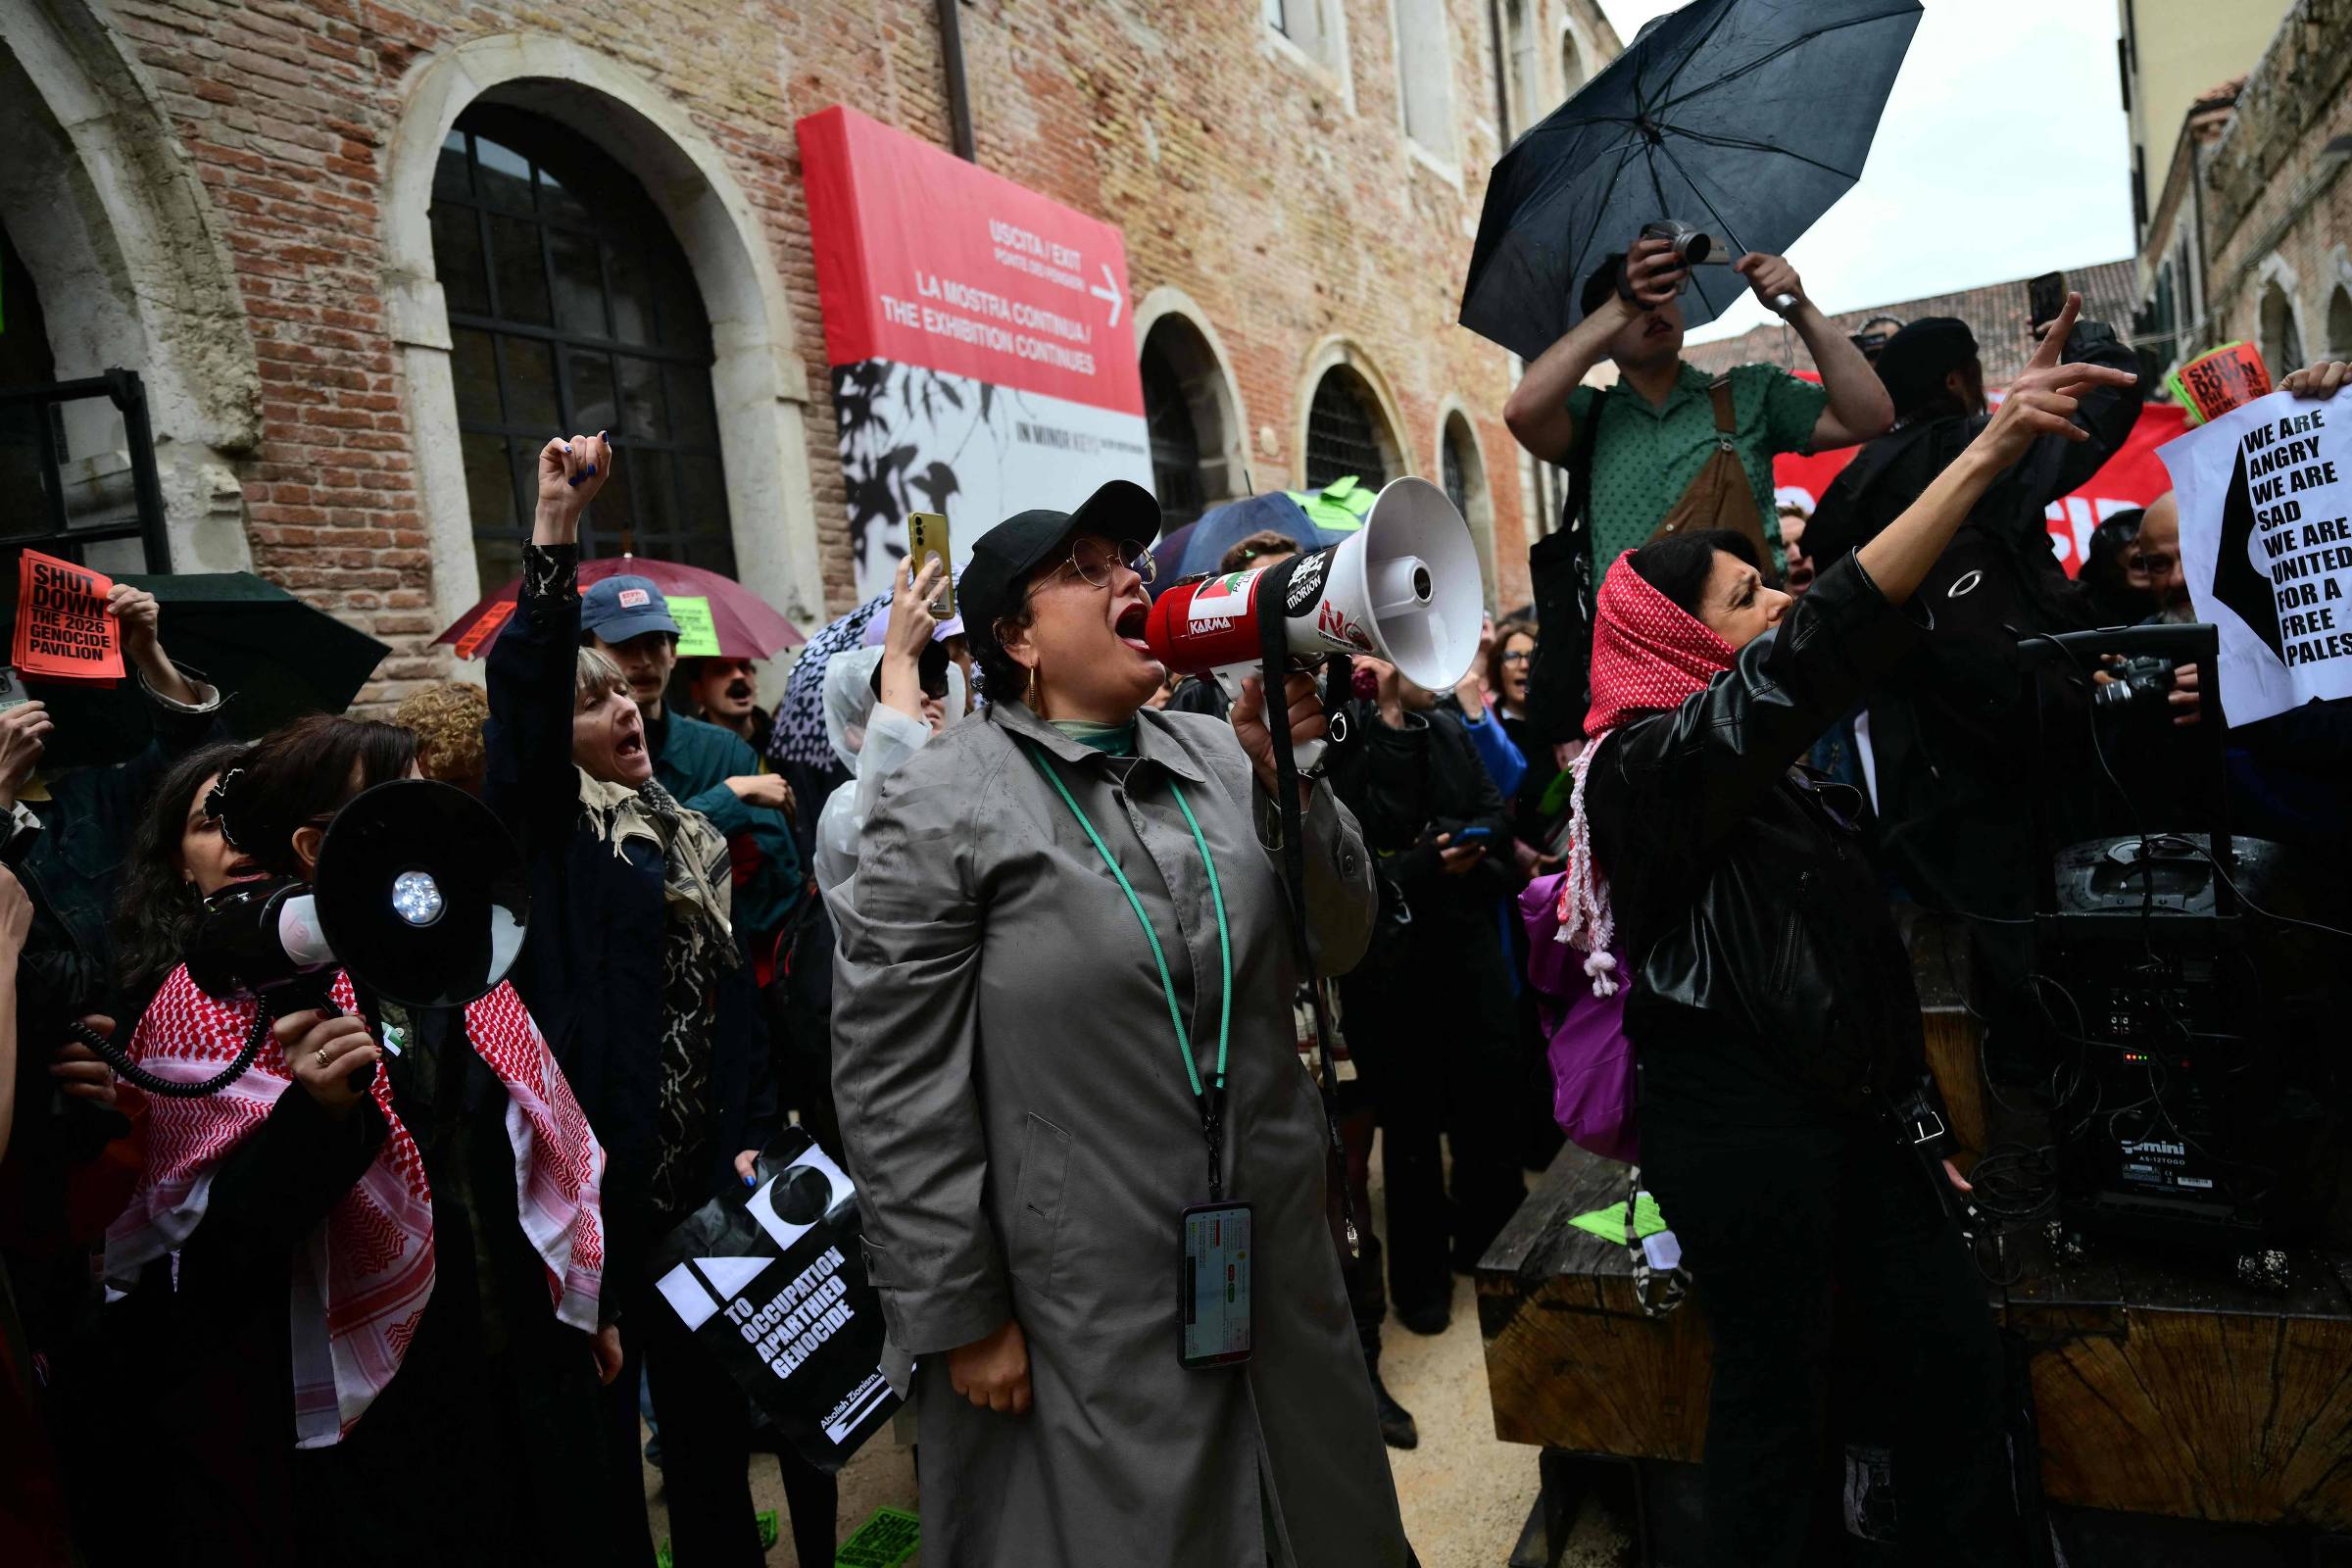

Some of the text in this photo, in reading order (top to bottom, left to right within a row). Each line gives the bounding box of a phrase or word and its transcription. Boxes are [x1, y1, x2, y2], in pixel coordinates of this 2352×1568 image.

[988, 217, 1043, 255] USCITA
[1051, 243, 1082, 272] EXIT
[915, 270, 943, 300] LA
[943, 278, 1011, 321] MOSTRA
[1011, 302, 1086, 342] CONTINUA
[880, 295, 1096, 376] THE EXHIBITION CONTINUES
[2188, 351, 2238, 384] SHUT
[2243, 410, 2325, 455] WE ARE
[2250, 435, 2320, 480] ANGRY
[2252, 461, 2338, 506] WE ARE
[2257, 500, 2301, 532] SAD
[2263, 517, 2352, 559] WE ARE
[33, 564, 94, 596] SHUT
[2272, 546, 2352, 586] UNITED
[33, 585, 106, 619] DOWN
[1286, 574, 1321, 610] MORION
[2277, 578, 2342, 613] FOR A
[29, 623, 111, 649] GENOCIDE
[31, 608, 106, 633] THE 2026
[1190, 616, 1231, 635] KARMA
[2281, 608, 2336, 640] FREE
[29, 639, 104, 661] PAVILION
[723, 1297, 754, 1326] TO
[740, 1245, 846, 1345] OCCUPATION
[755, 1274, 848, 1364] APARTHIED
[770, 1298, 855, 1380] GENOCIDE
[820, 1373, 879, 1430] Abolish Zionism.
